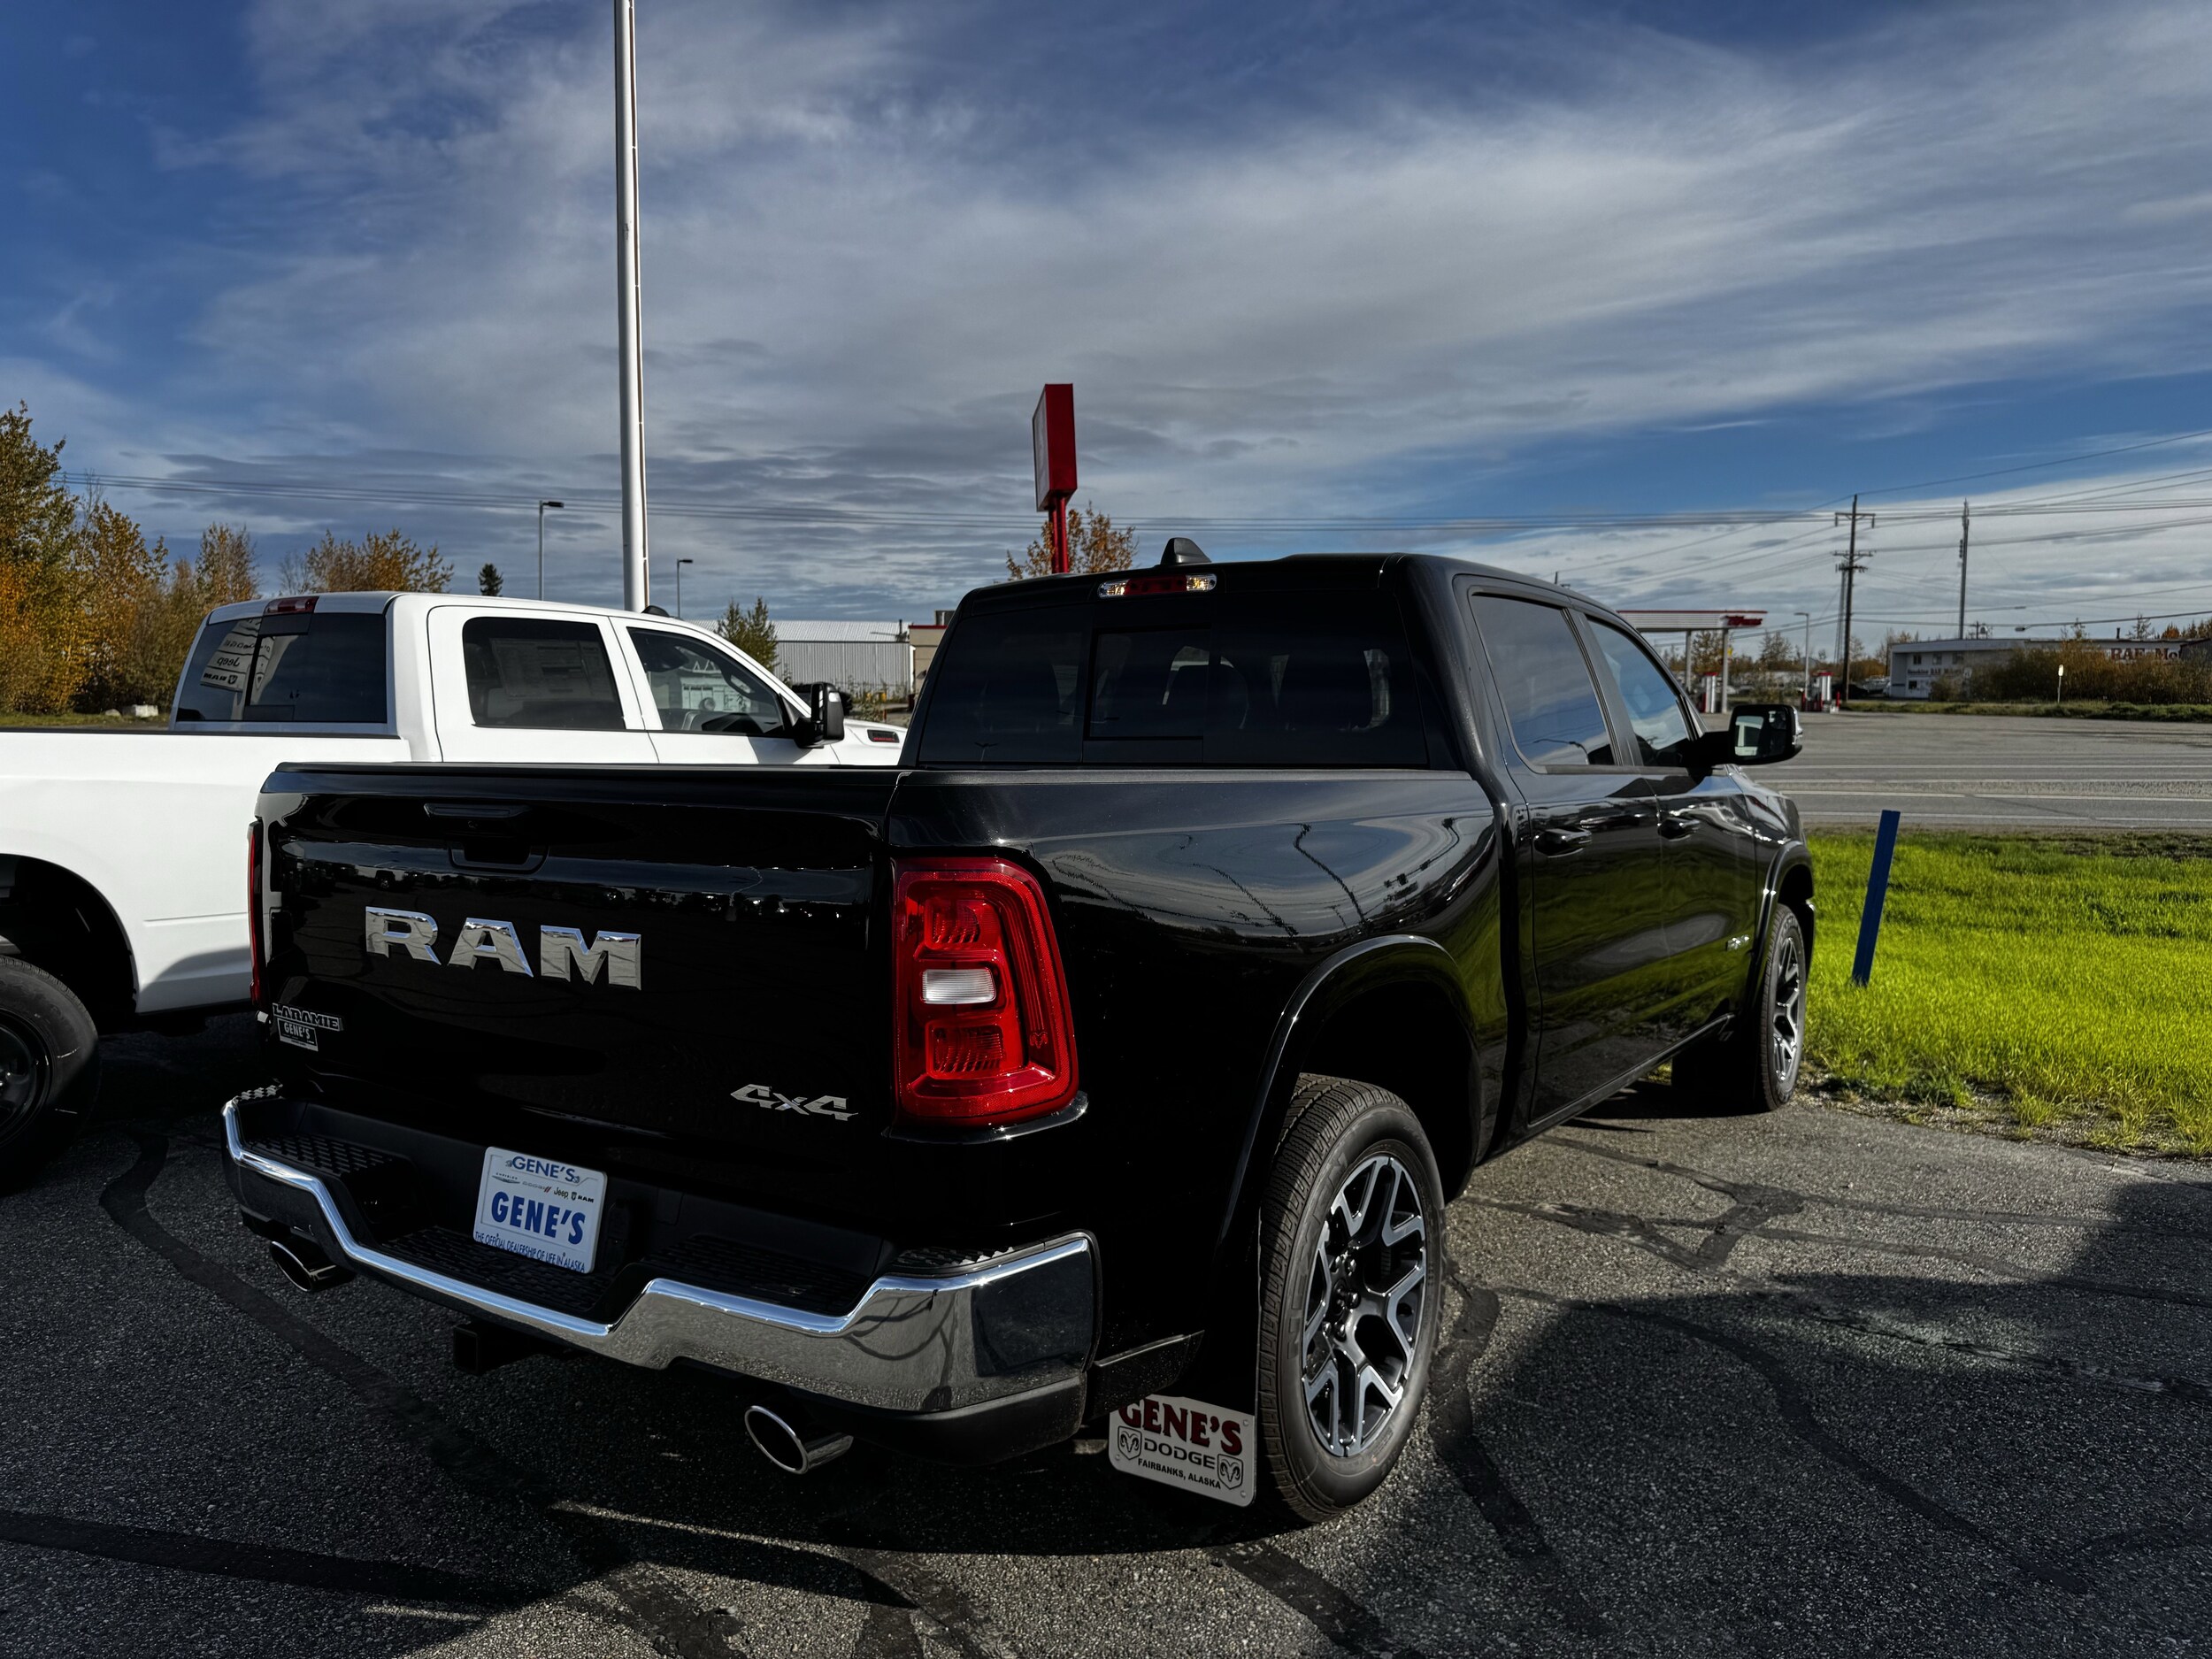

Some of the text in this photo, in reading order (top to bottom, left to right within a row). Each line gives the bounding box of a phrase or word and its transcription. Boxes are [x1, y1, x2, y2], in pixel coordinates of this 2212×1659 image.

[365, 907, 641, 991] RAM
[273, 1002, 342, 1032] LARAMIE
[284, 1022, 311, 1040] GENE'S
[512, 1156, 576, 1182] GENE'S
[554, 1187, 569, 1199] Jeep
[491, 1191, 586, 1245] GENE'S
[474, 1231, 585, 1272] THE OFFICIAL DEALERSHIP OF LIFE IN ALASKA
[1118, 1398, 1242, 1455] GENE'S
[1144, 1438, 1216, 1470] DODGE
[1138, 1457, 1221, 1490] FAIRBANKS, ALASKA
